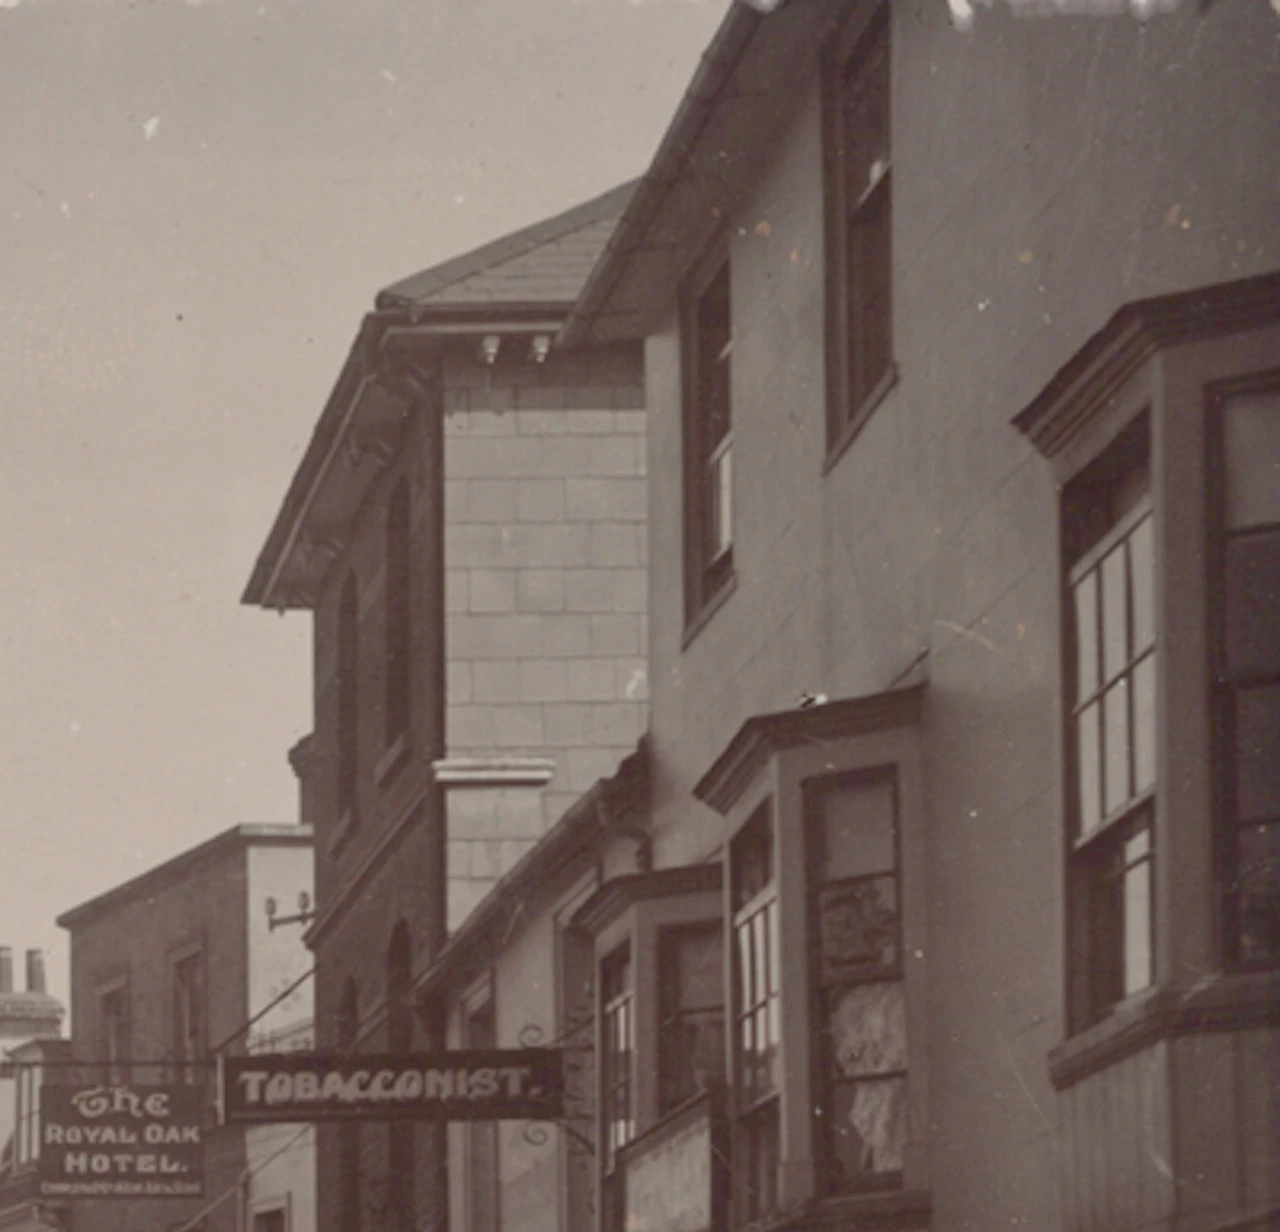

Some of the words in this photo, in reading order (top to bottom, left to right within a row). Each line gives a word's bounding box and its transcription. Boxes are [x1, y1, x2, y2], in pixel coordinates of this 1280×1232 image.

[237, 1066, 544, 1105] TOBACCONIST.
[69, 1084, 171, 1118] The
[44, 1121, 138, 1145] ROYAL
[143, 1121, 201, 1145] OAK
[63, 1150, 190, 1175] HOTEL.
